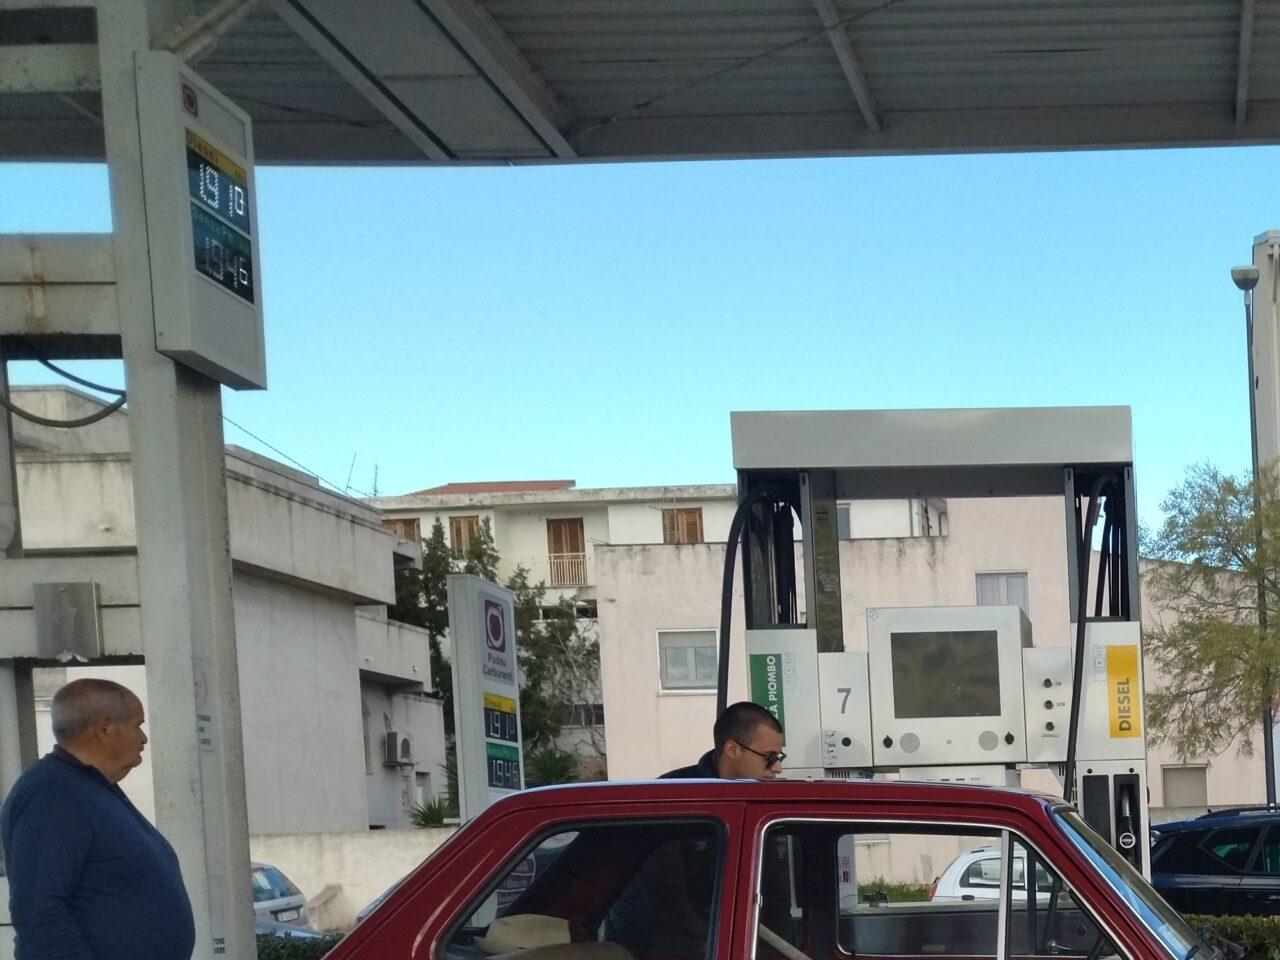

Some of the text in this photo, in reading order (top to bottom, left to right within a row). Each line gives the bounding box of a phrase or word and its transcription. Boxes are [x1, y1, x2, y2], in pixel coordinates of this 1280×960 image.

[766, 655, 779, 701] PIOMBO
[837, 687, 852, 714] 7
[1117, 677, 1132, 732] DIESEL
